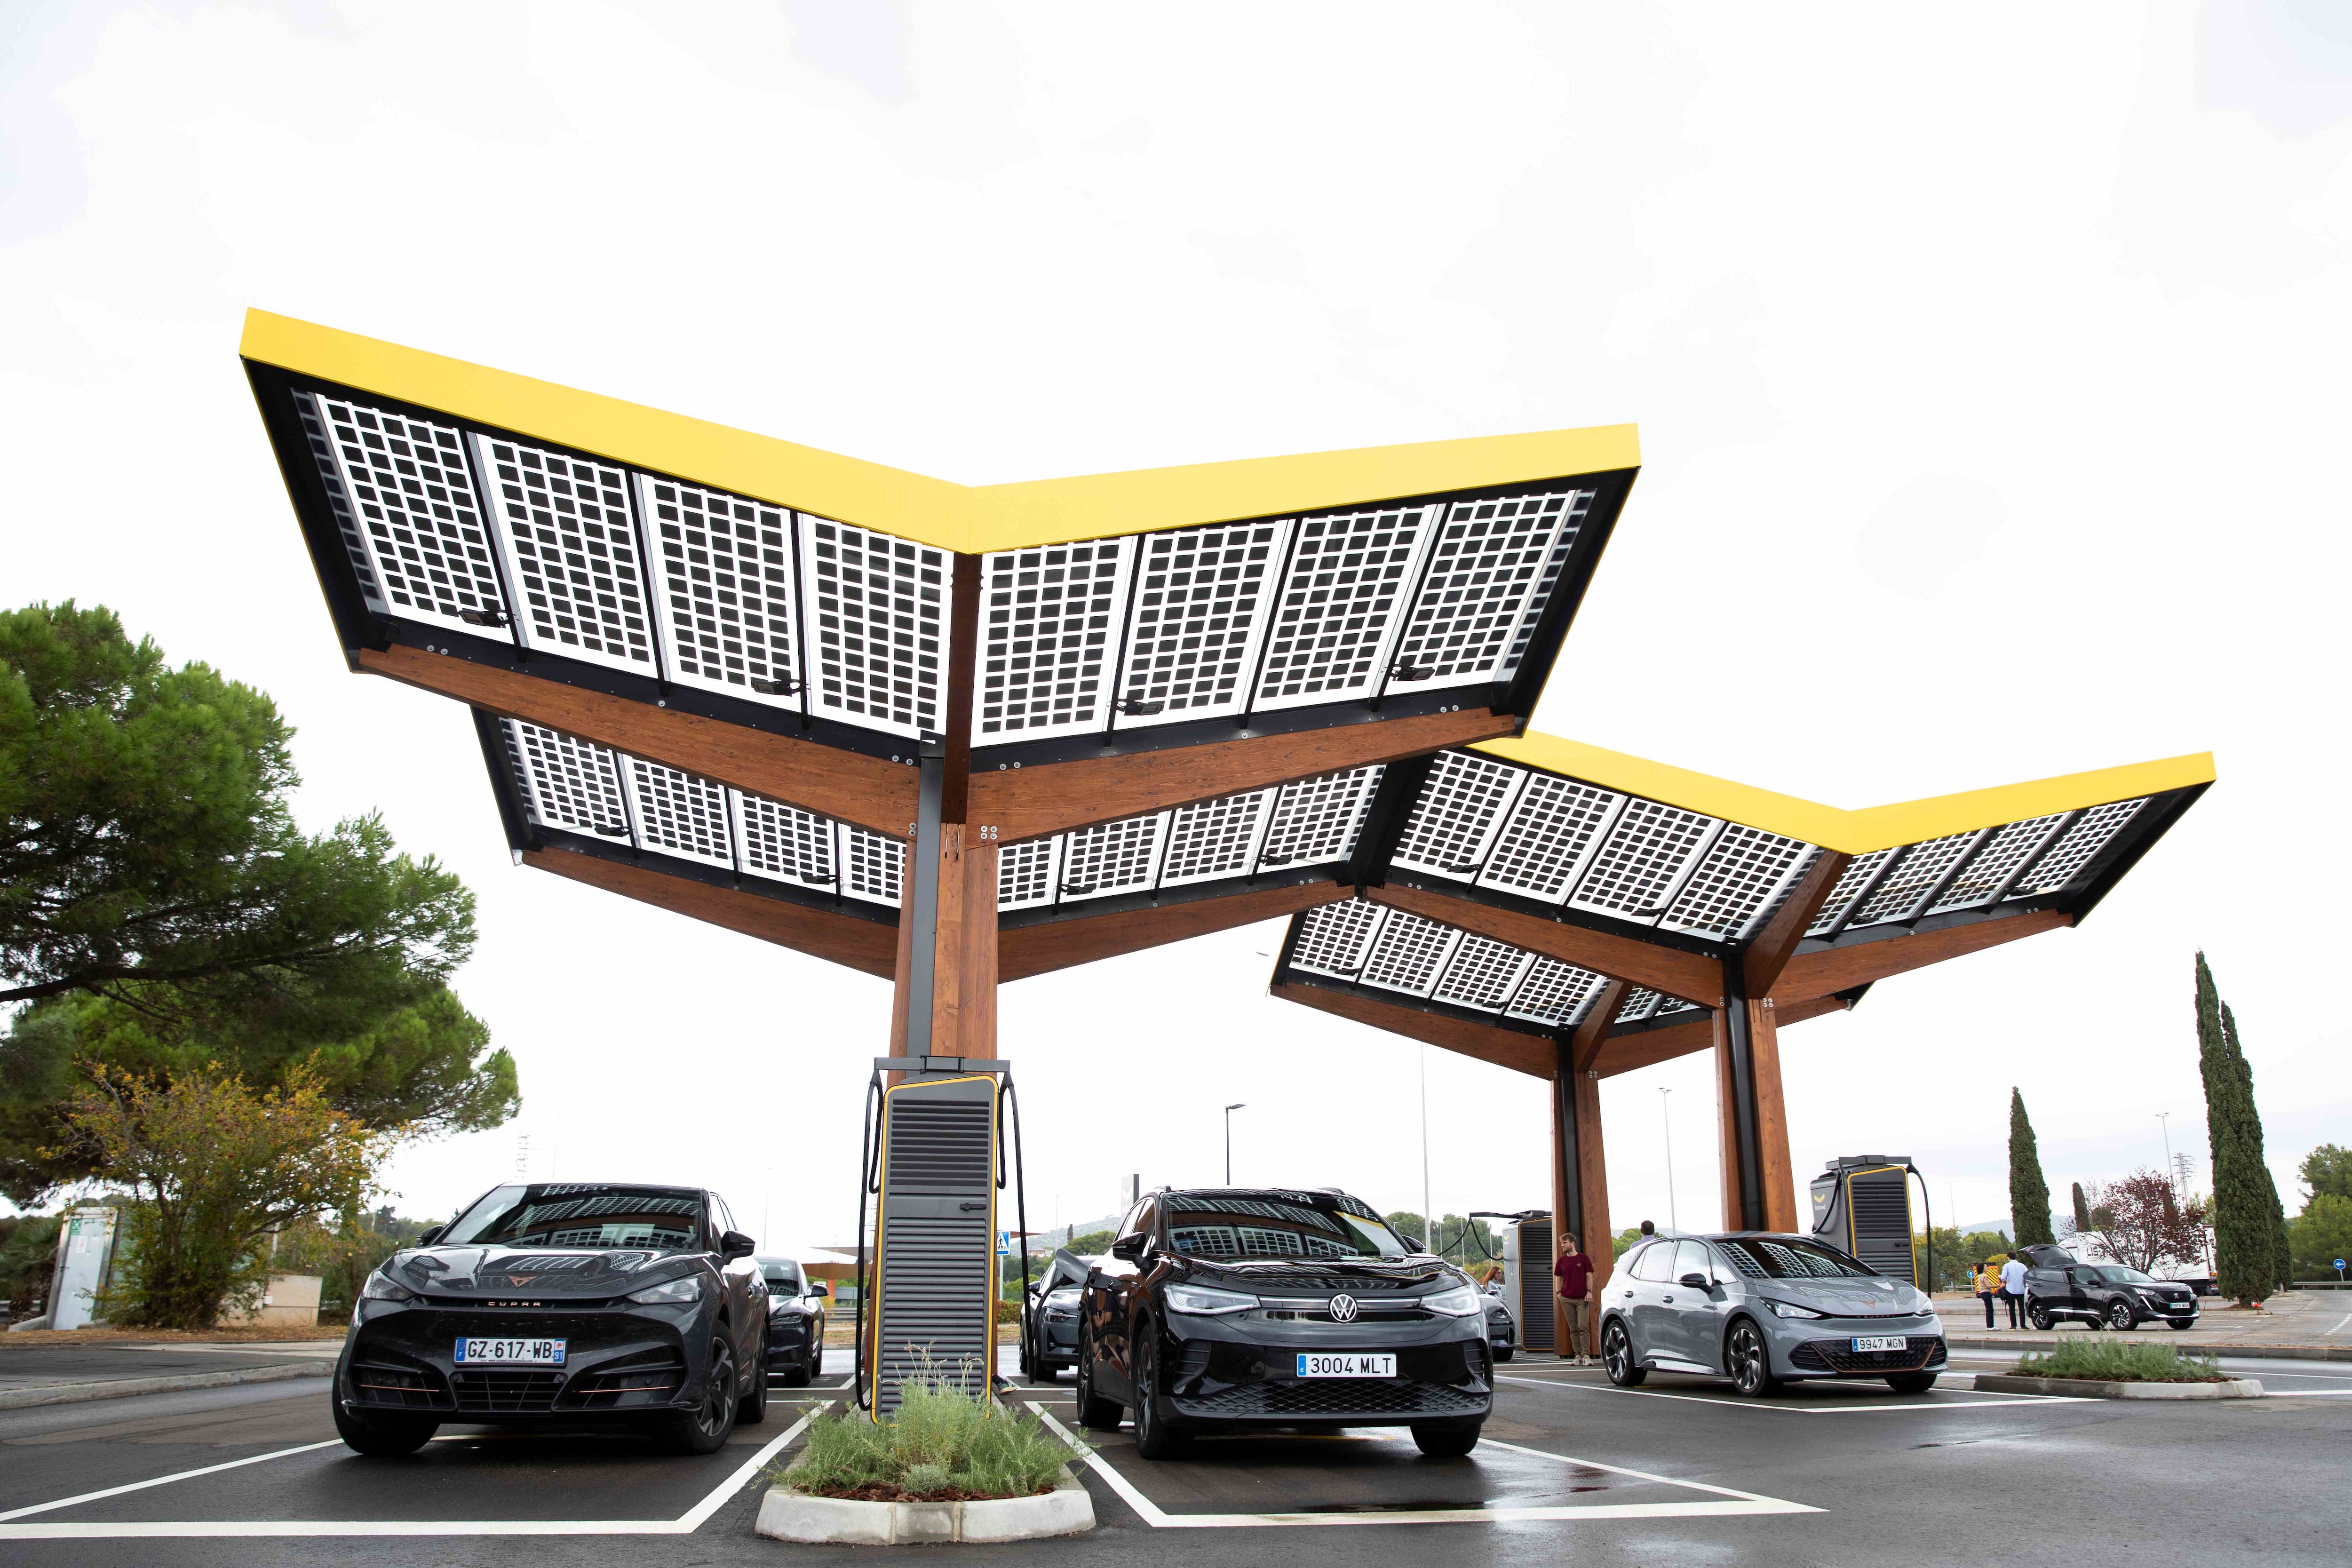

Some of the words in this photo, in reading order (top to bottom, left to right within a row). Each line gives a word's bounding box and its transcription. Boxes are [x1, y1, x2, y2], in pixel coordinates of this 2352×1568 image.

[468, 1341, 552, 1359] GZ-617-WB
[1859, 1339, 1883, 1349] 9947
[1886, 1338, 1904, 1348] MGN
[554, 1351, 563, 1360] 91
[1311, 1357, 1353, 1374] 3004
[1360, 1357, 1391, 1374] MLT
